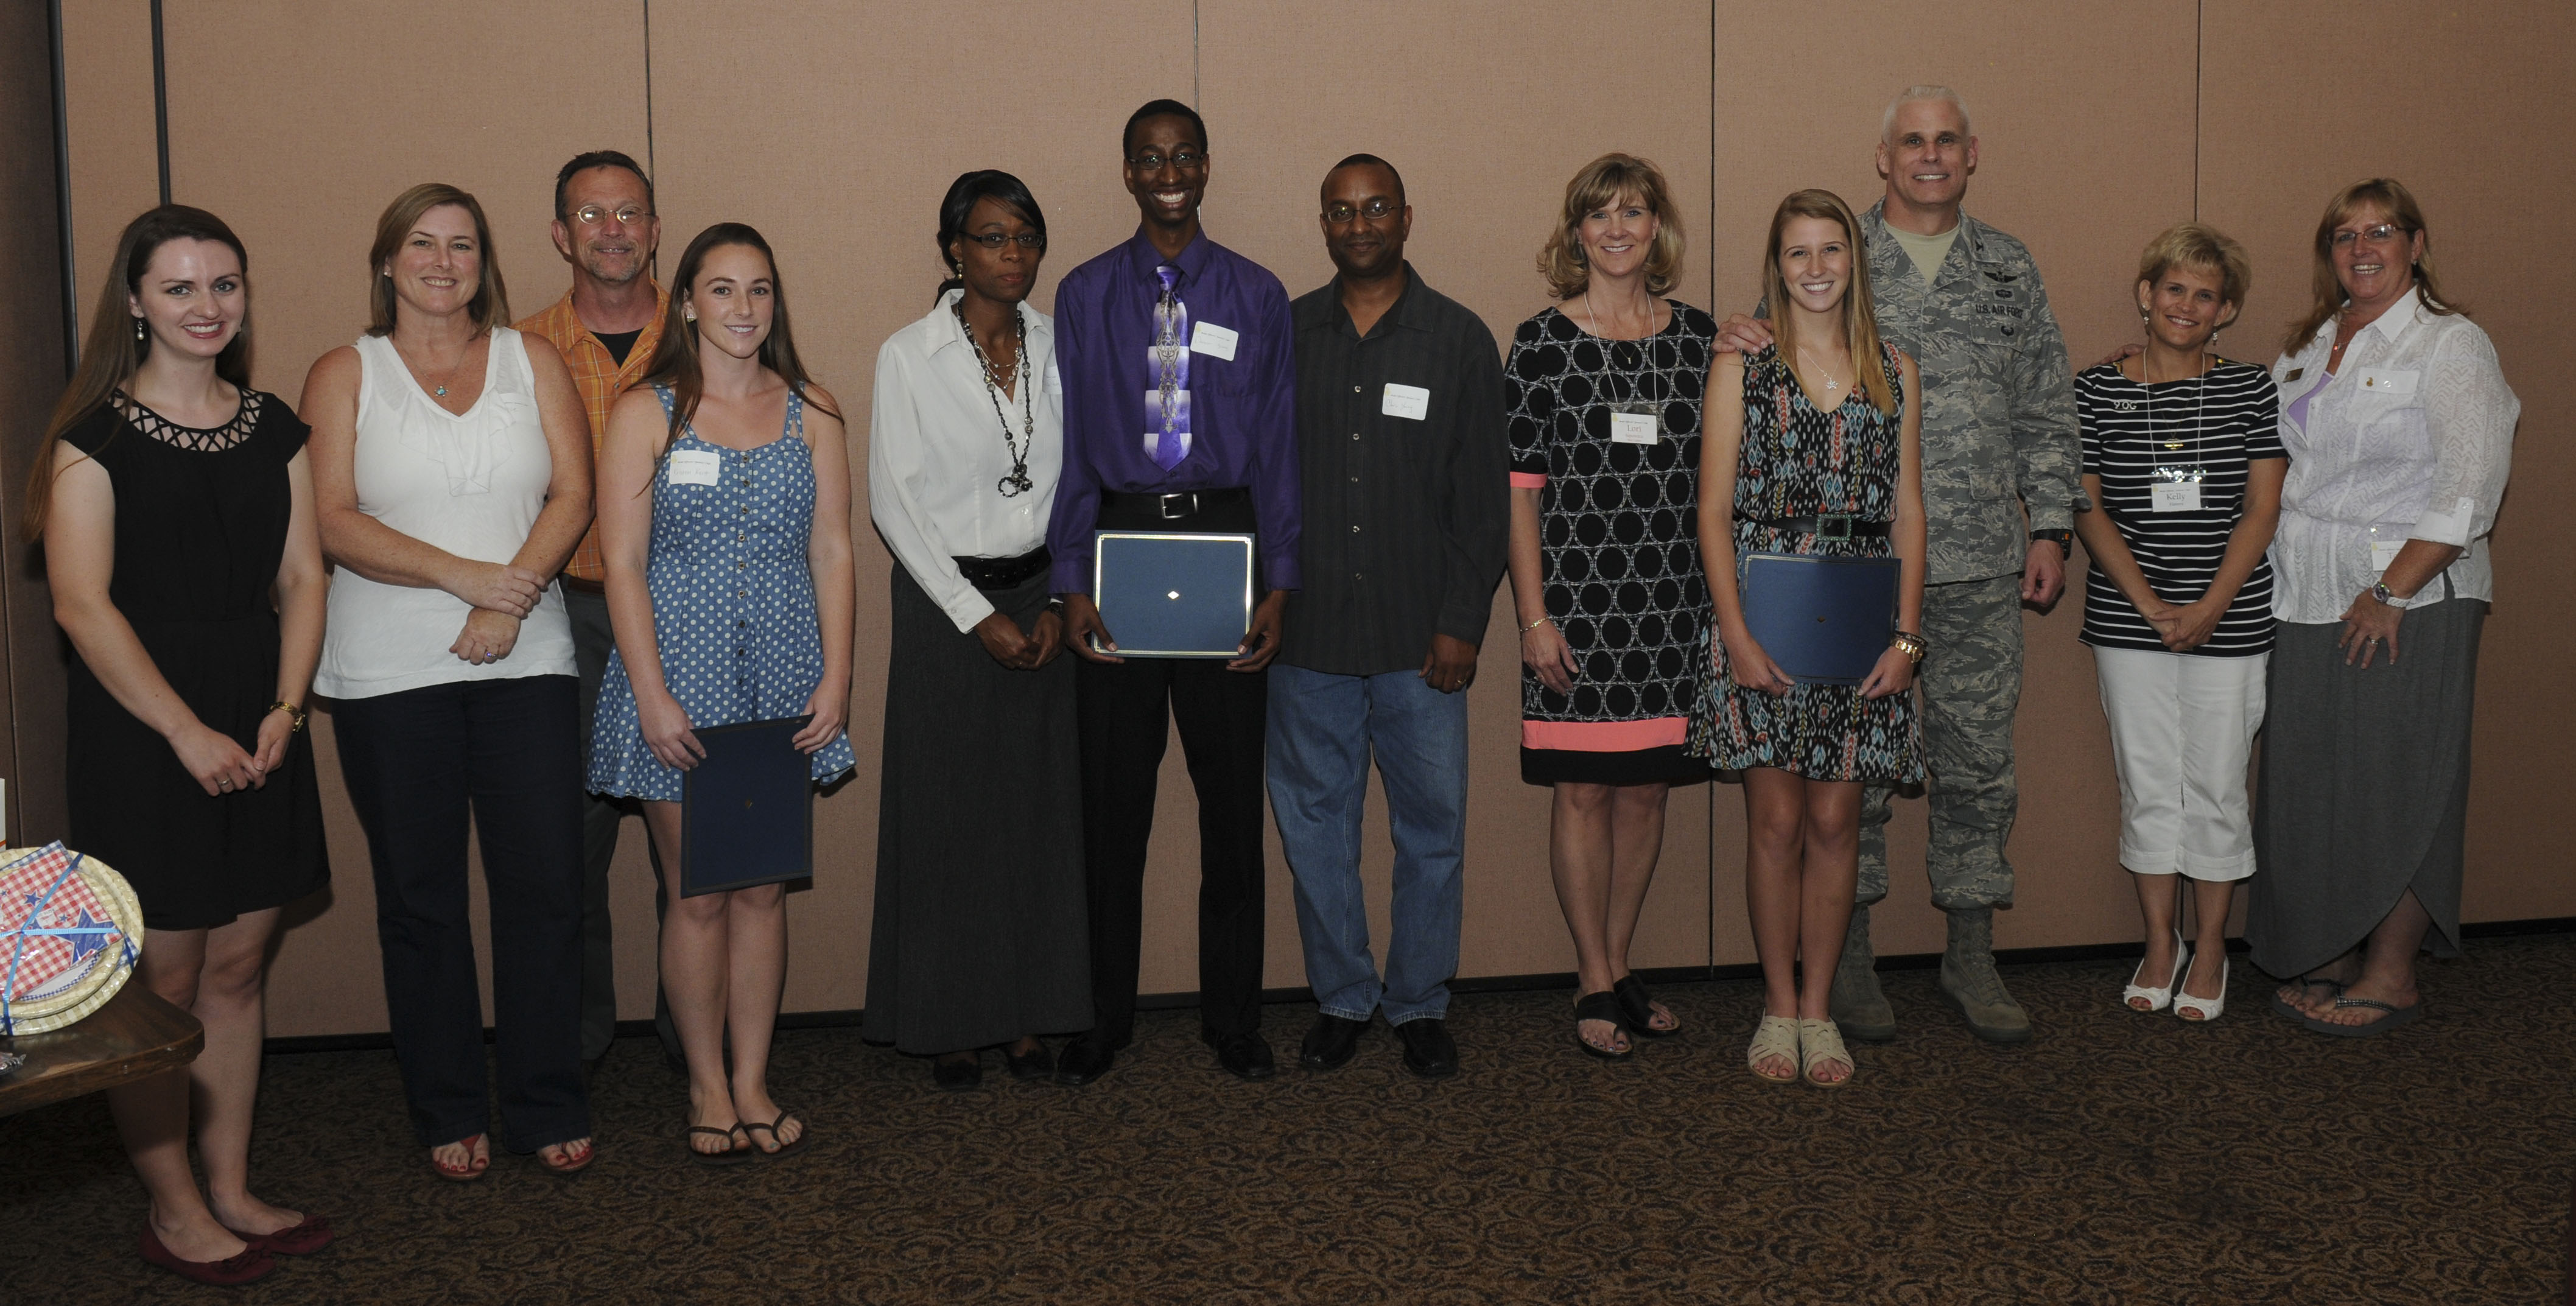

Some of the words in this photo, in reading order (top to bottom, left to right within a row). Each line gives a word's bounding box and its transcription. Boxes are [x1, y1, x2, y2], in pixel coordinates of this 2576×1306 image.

[1975, 304, 1991, 314] U.S.
[1992, 304, 2006, 315] AIR
[2166, 493, 2186, 502] Kelly
